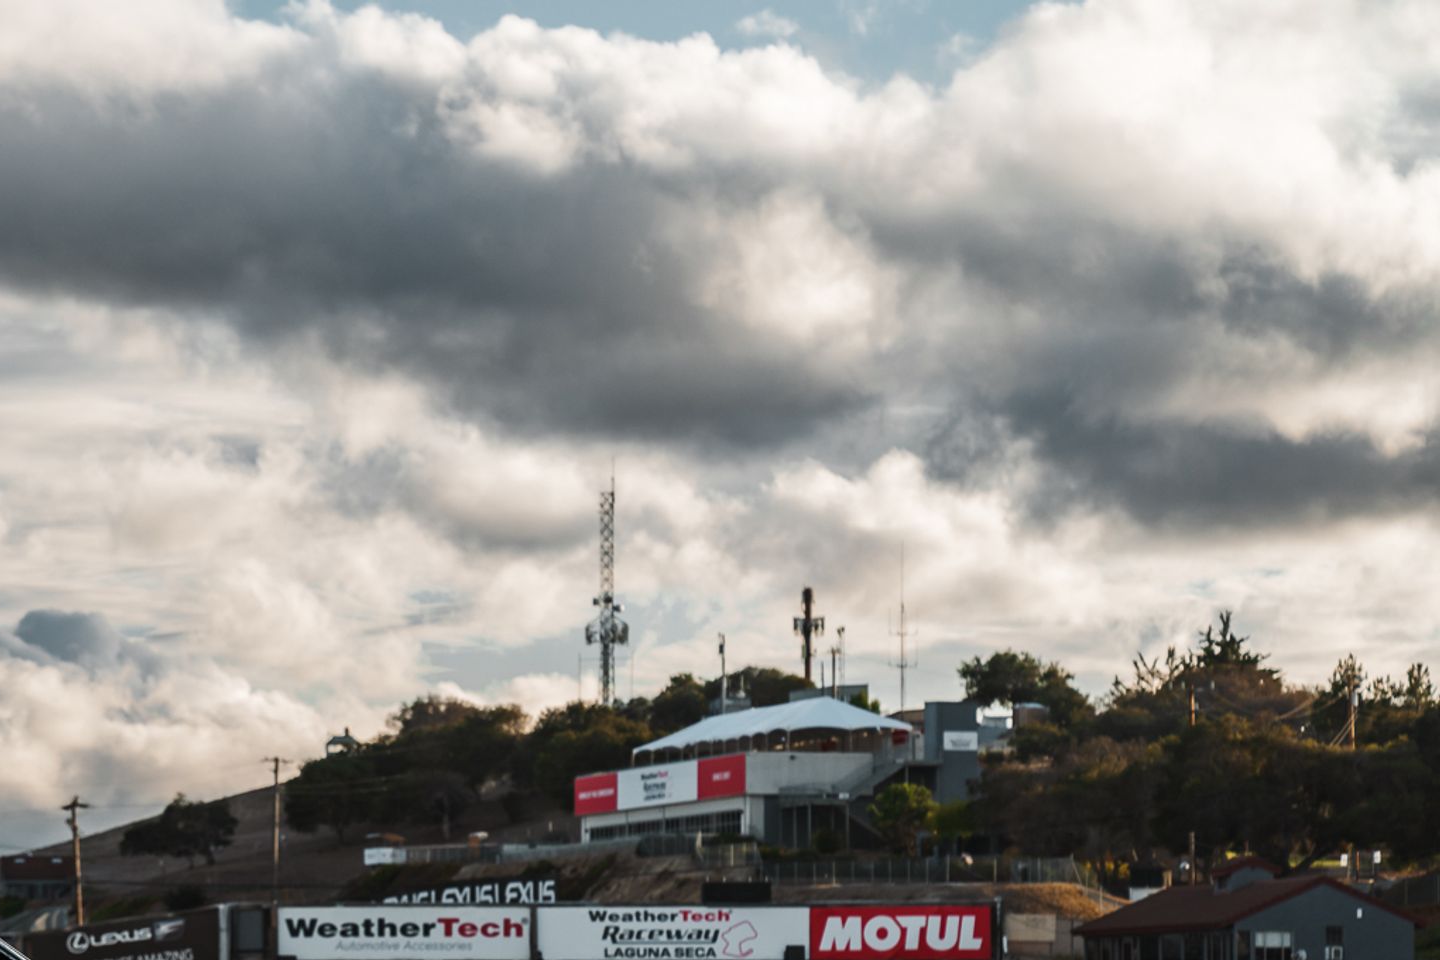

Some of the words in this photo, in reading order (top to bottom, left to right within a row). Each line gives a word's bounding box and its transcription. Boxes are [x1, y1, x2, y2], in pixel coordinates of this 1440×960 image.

[588, 910, 730, 922] WeatherTech
[90, 927, 153, 947] LEXUS
[285, 917, 524, 938] WeatherTech
[602, 925, 720, 944] Raceway
[819, 914, 984, 952] MOTUL
[335, 940, 400, 951] Automotive
[403, 940, 474, 951] Accessories
[604, 947, 672, 959] LAGUNA
[674, 947, 717, 959] SECA
